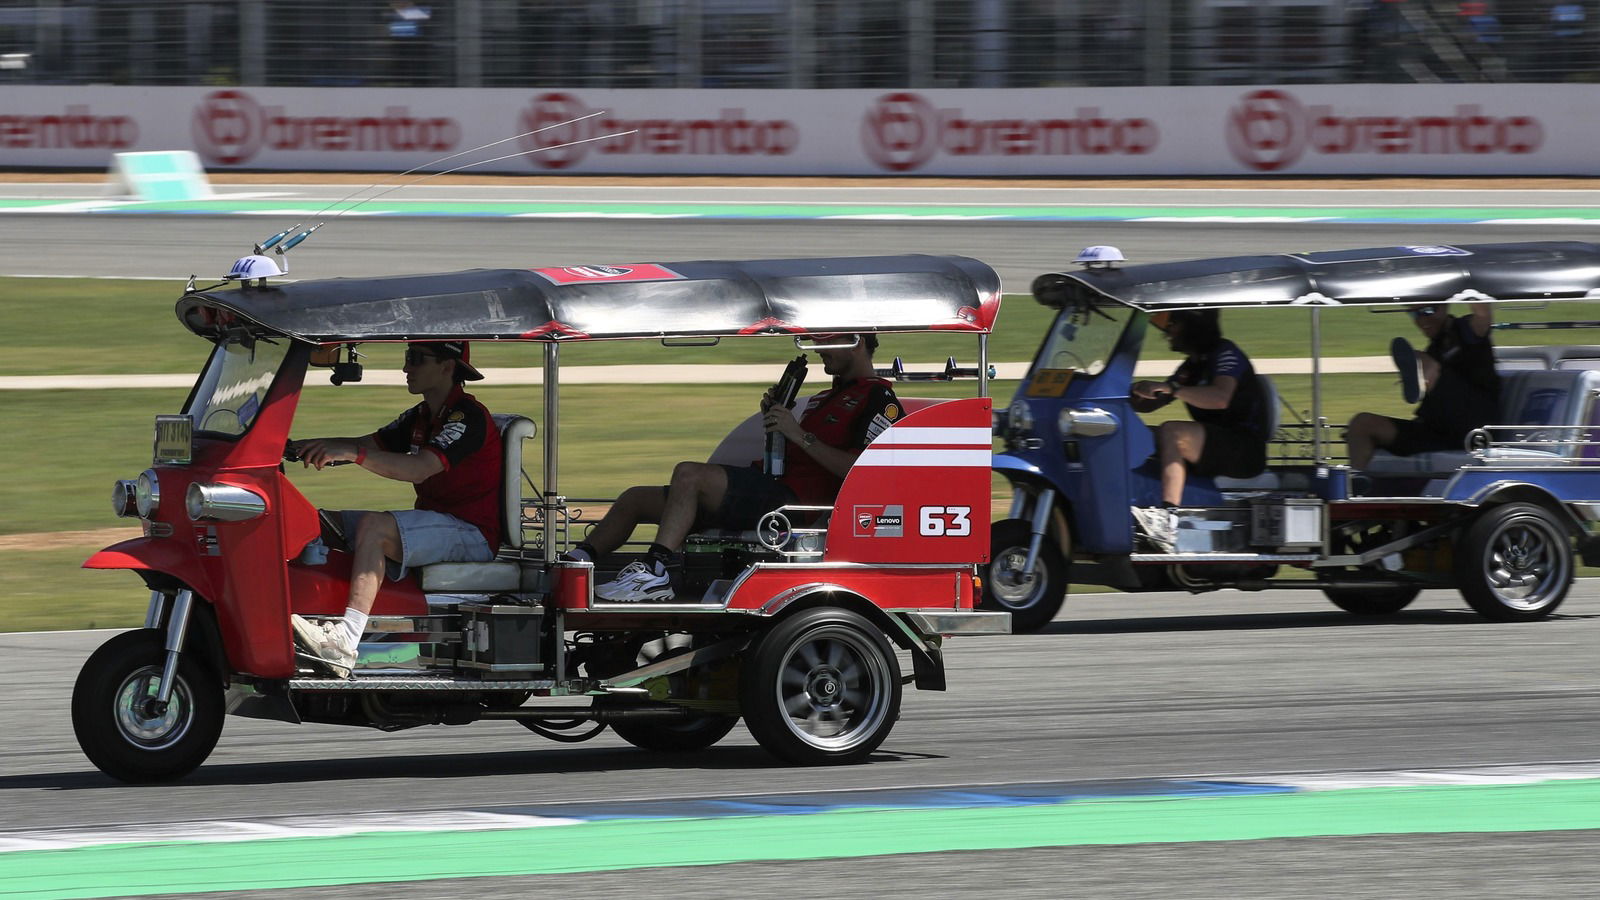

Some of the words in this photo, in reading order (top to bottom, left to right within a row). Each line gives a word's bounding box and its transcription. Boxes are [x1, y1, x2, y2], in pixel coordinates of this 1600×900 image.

[265, 106, 461, 151] brembo
[592, 108, 798, 155] brembo
[939, 107, 1160, 155] brembo
[1307, 104, 1544, 153] brembo
[920, 506, 971, 536] 63
